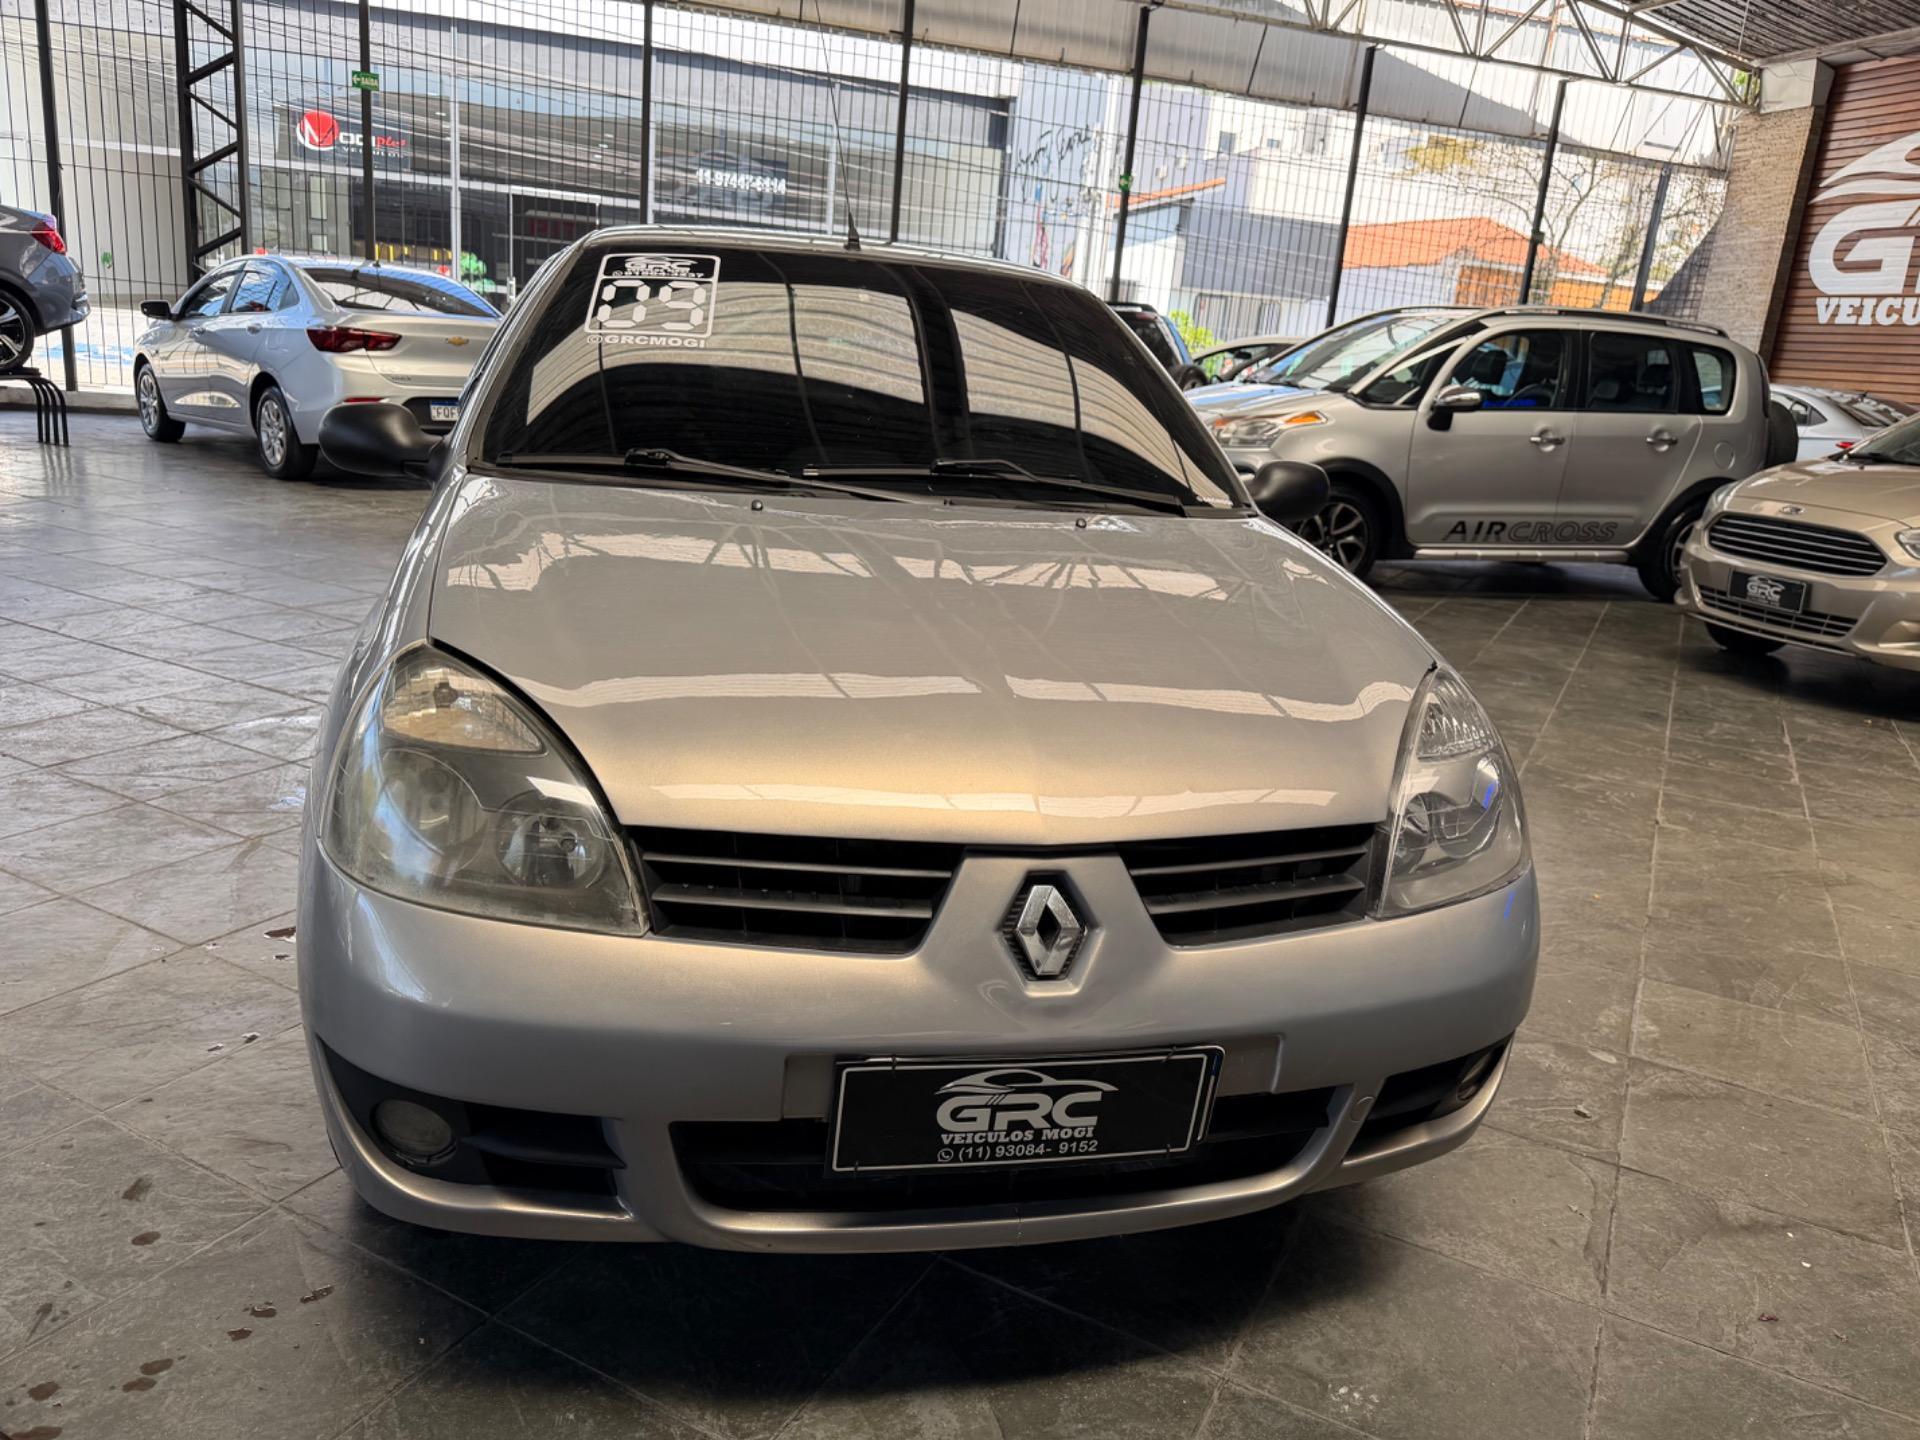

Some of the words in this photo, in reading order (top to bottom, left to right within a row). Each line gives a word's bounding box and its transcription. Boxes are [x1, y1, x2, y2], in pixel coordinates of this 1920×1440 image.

[1808, 198, 1920, 296] G
[597, 279, 706, 331] 09
[1442, 520, 1619, 542] AIRCROSS
[1746, 581, 1782, 599] GRC
[936, 1091, 1102, 1132] GRC
[941, 1130, 1034, 1145] VEICULOS
[1041, 1126, 1094, 1141] MOGI
[958, 1146, 991, 1161] (11)
[995, 1143, 1051, 1157] 93084-
[1058, 1140, 1098, 1154] 9152
